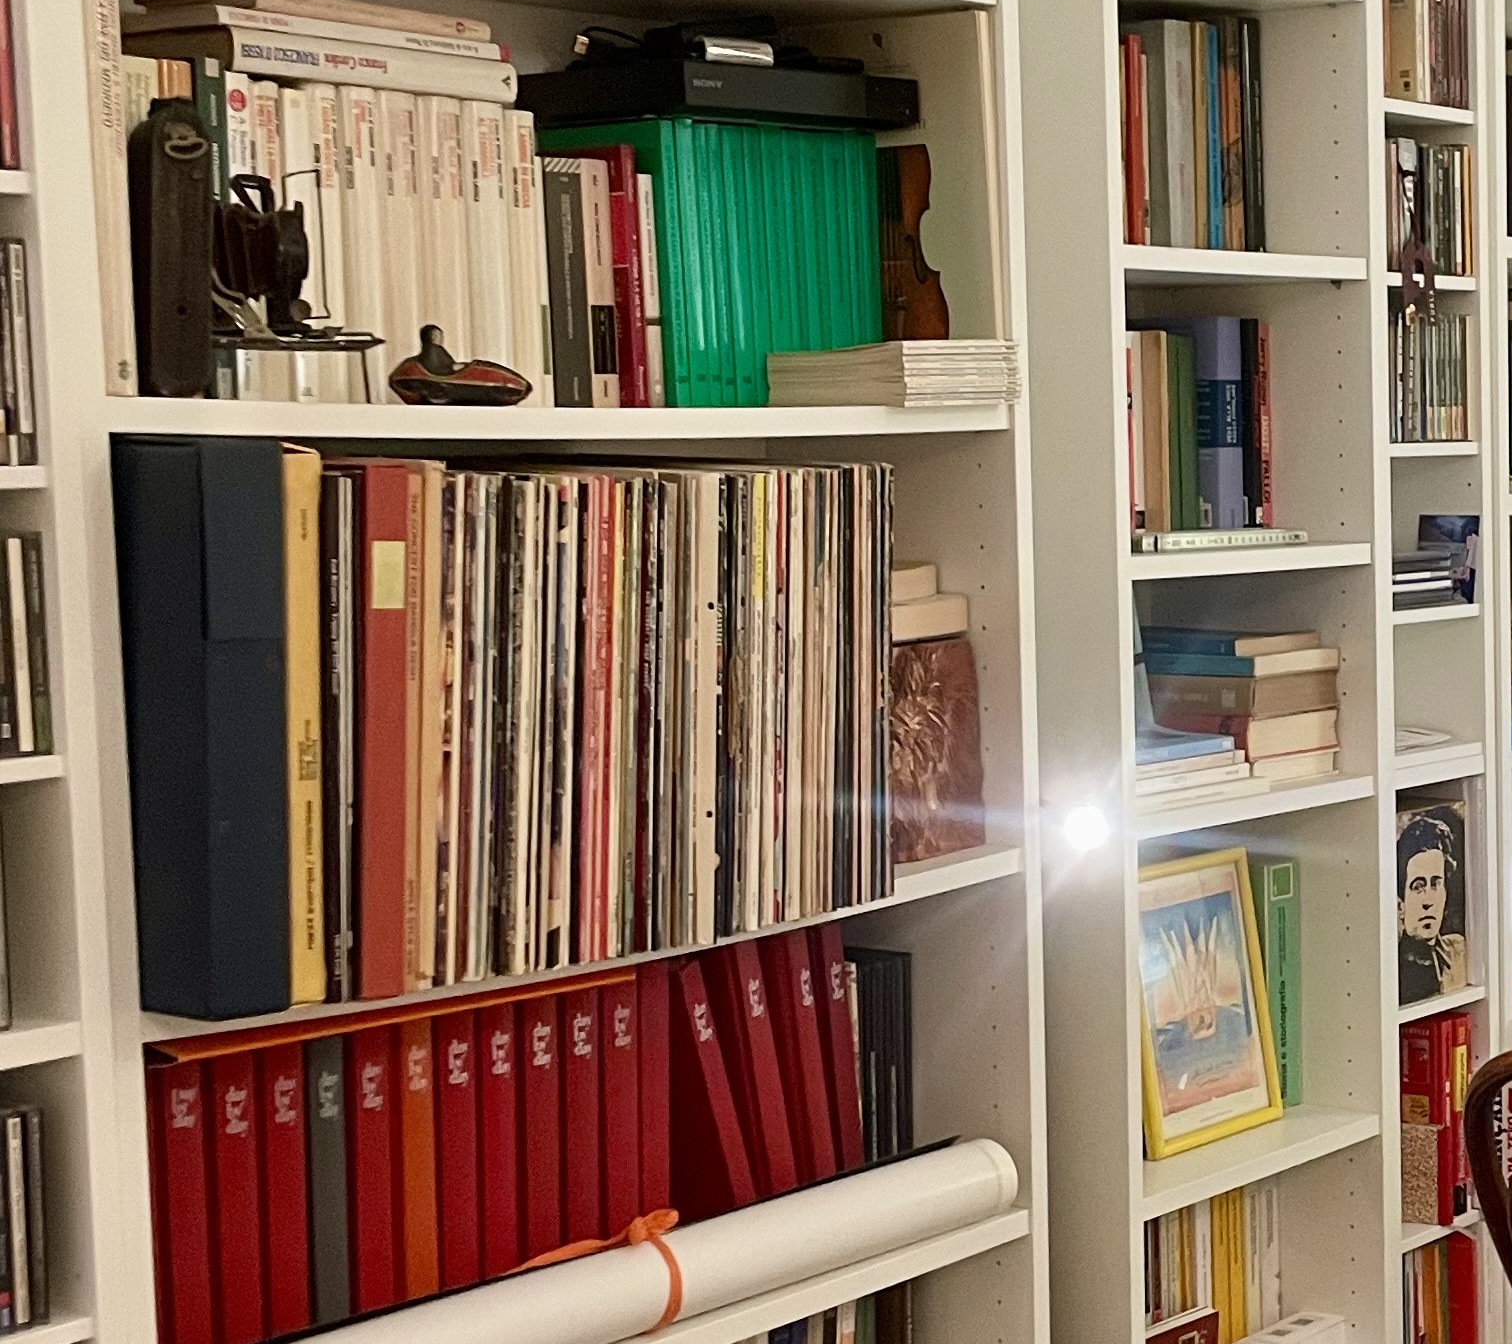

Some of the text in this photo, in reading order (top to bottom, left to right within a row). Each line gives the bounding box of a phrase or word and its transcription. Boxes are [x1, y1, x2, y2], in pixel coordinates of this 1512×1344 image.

[322, 52, 356, 70] Cardini
[357, 56, 388, 75] Franco
[1278, 980, 1288, 1047] storiografia
